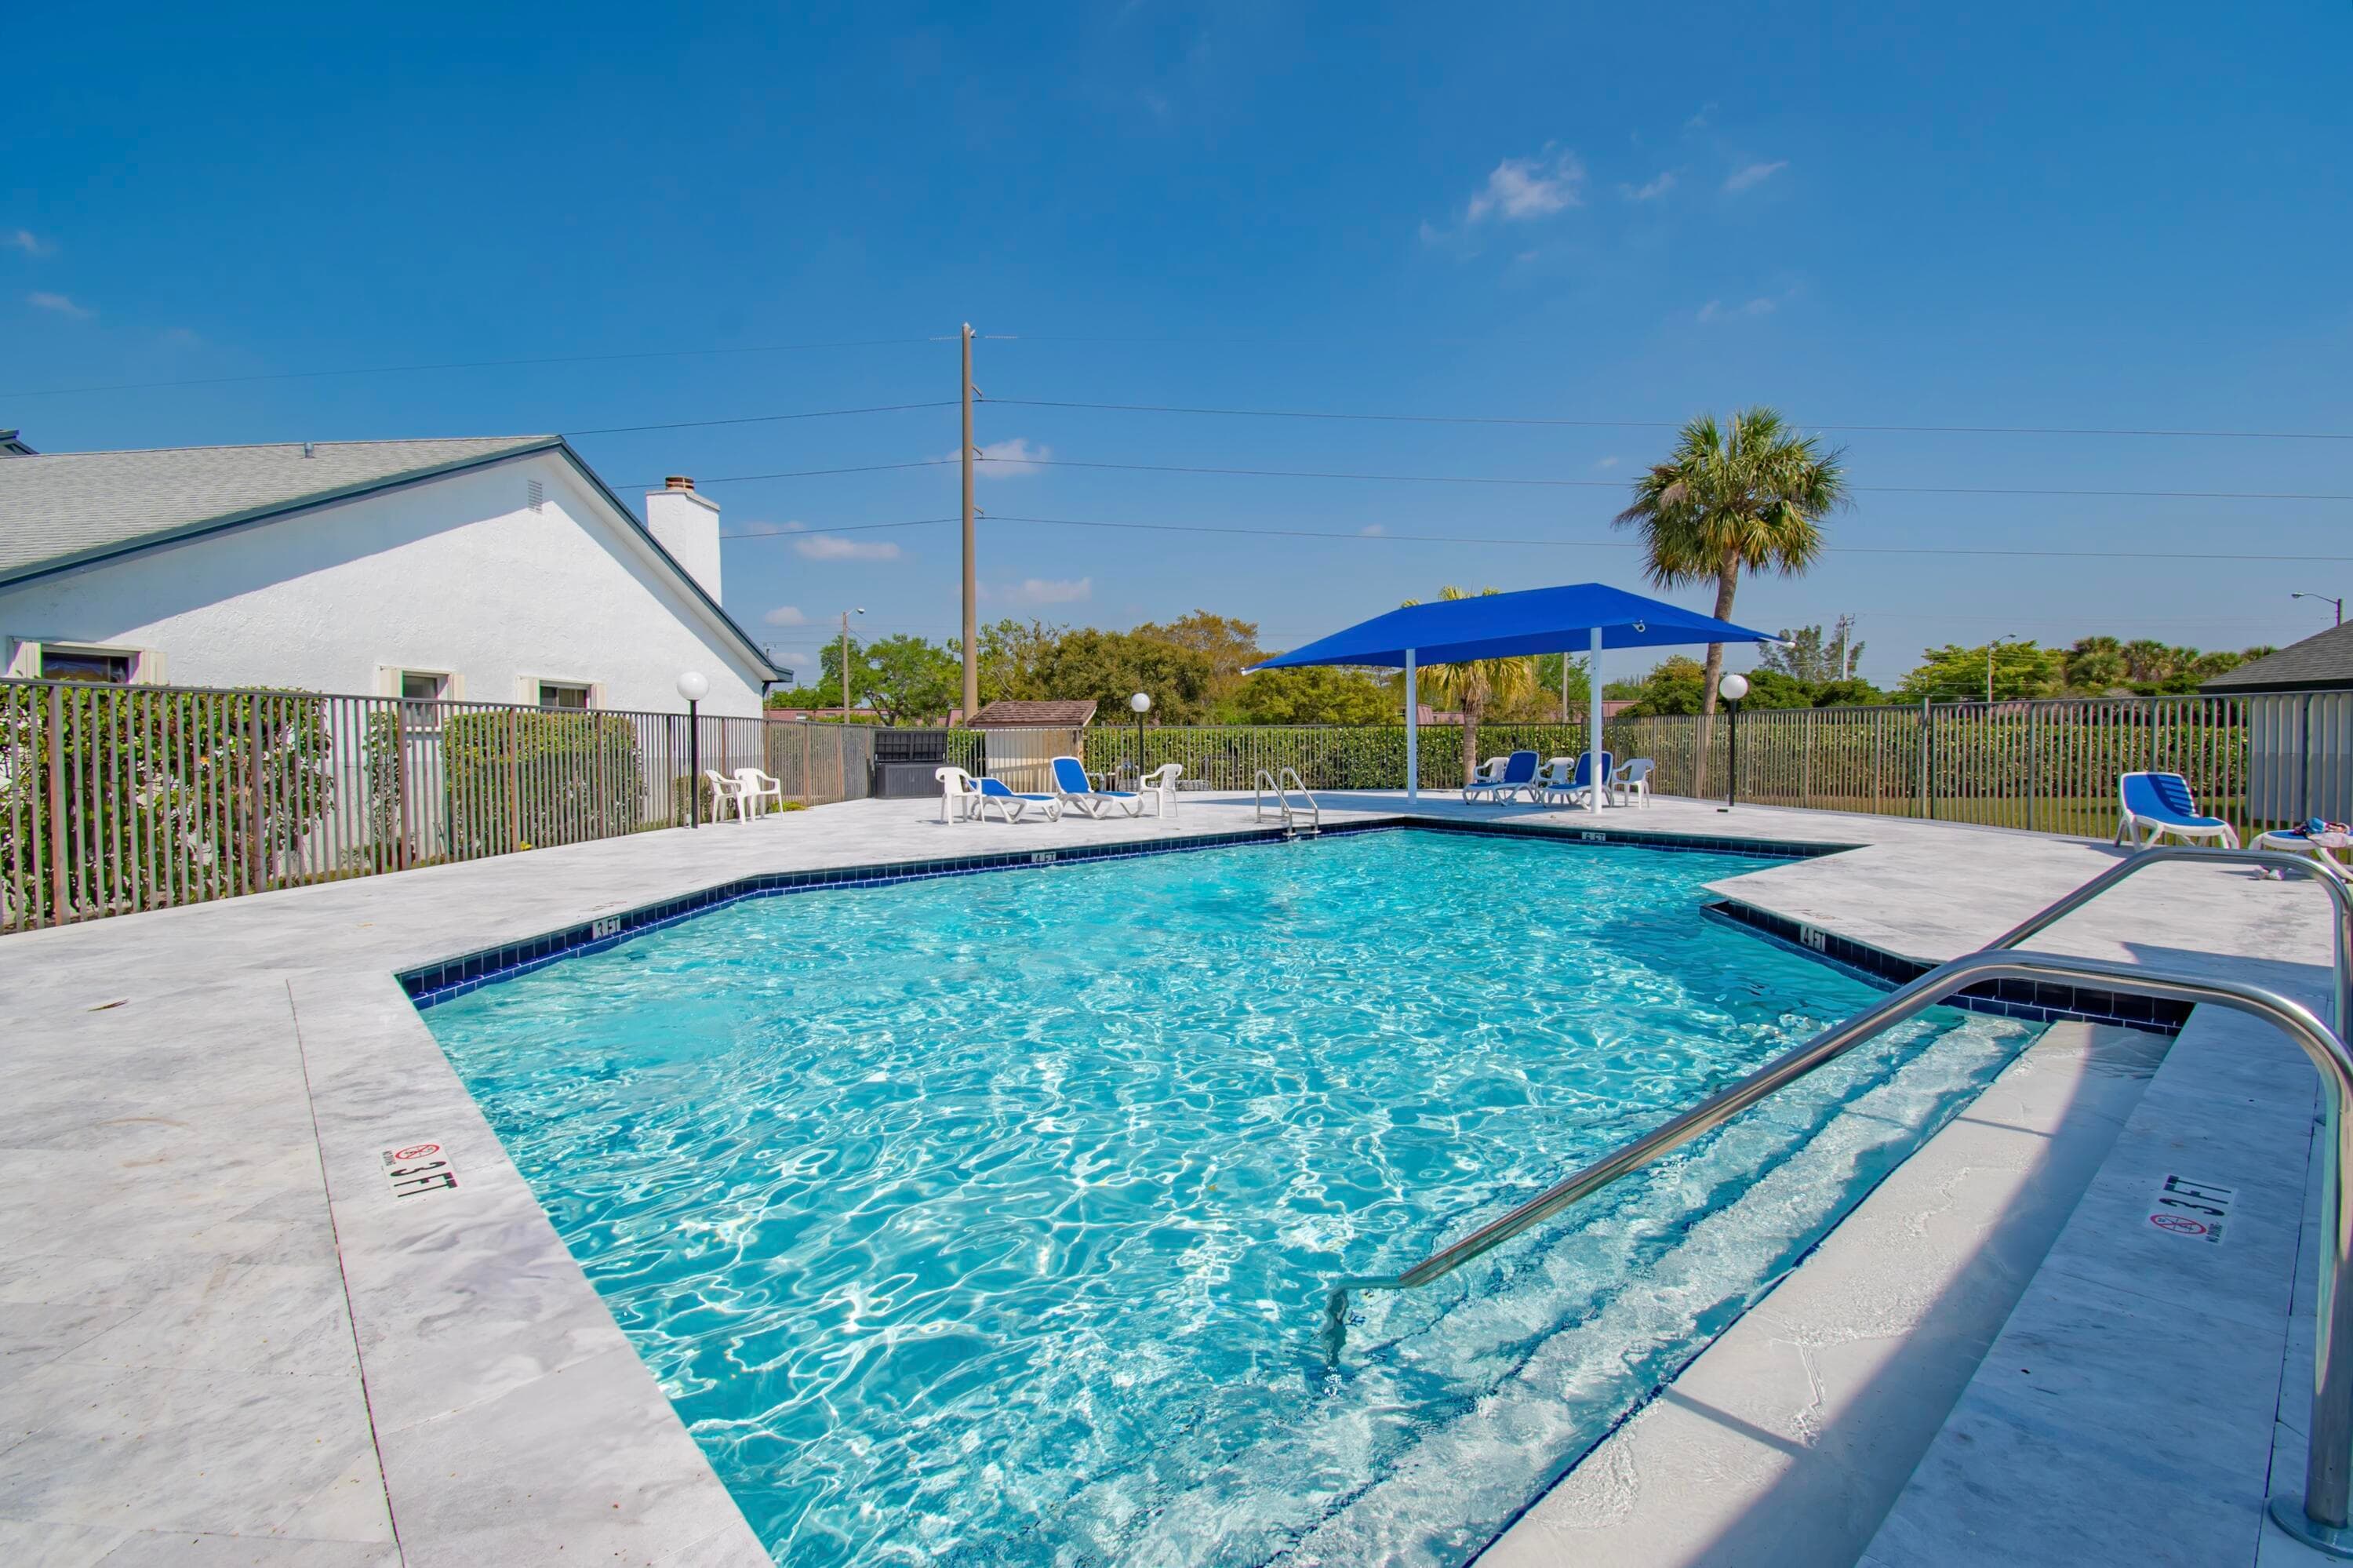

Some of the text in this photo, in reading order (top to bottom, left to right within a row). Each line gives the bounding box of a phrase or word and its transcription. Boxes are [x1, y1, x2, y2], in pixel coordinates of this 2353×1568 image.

[1044, 853, 1054, 862] FT
[598, 917, 619, 937] 3 FT
[1804, 927, 1824, 949] 4 FT
[391, 1161, 458, 1198] 3 FT
[2158, 1175, 2231, 1217] 3 FT
